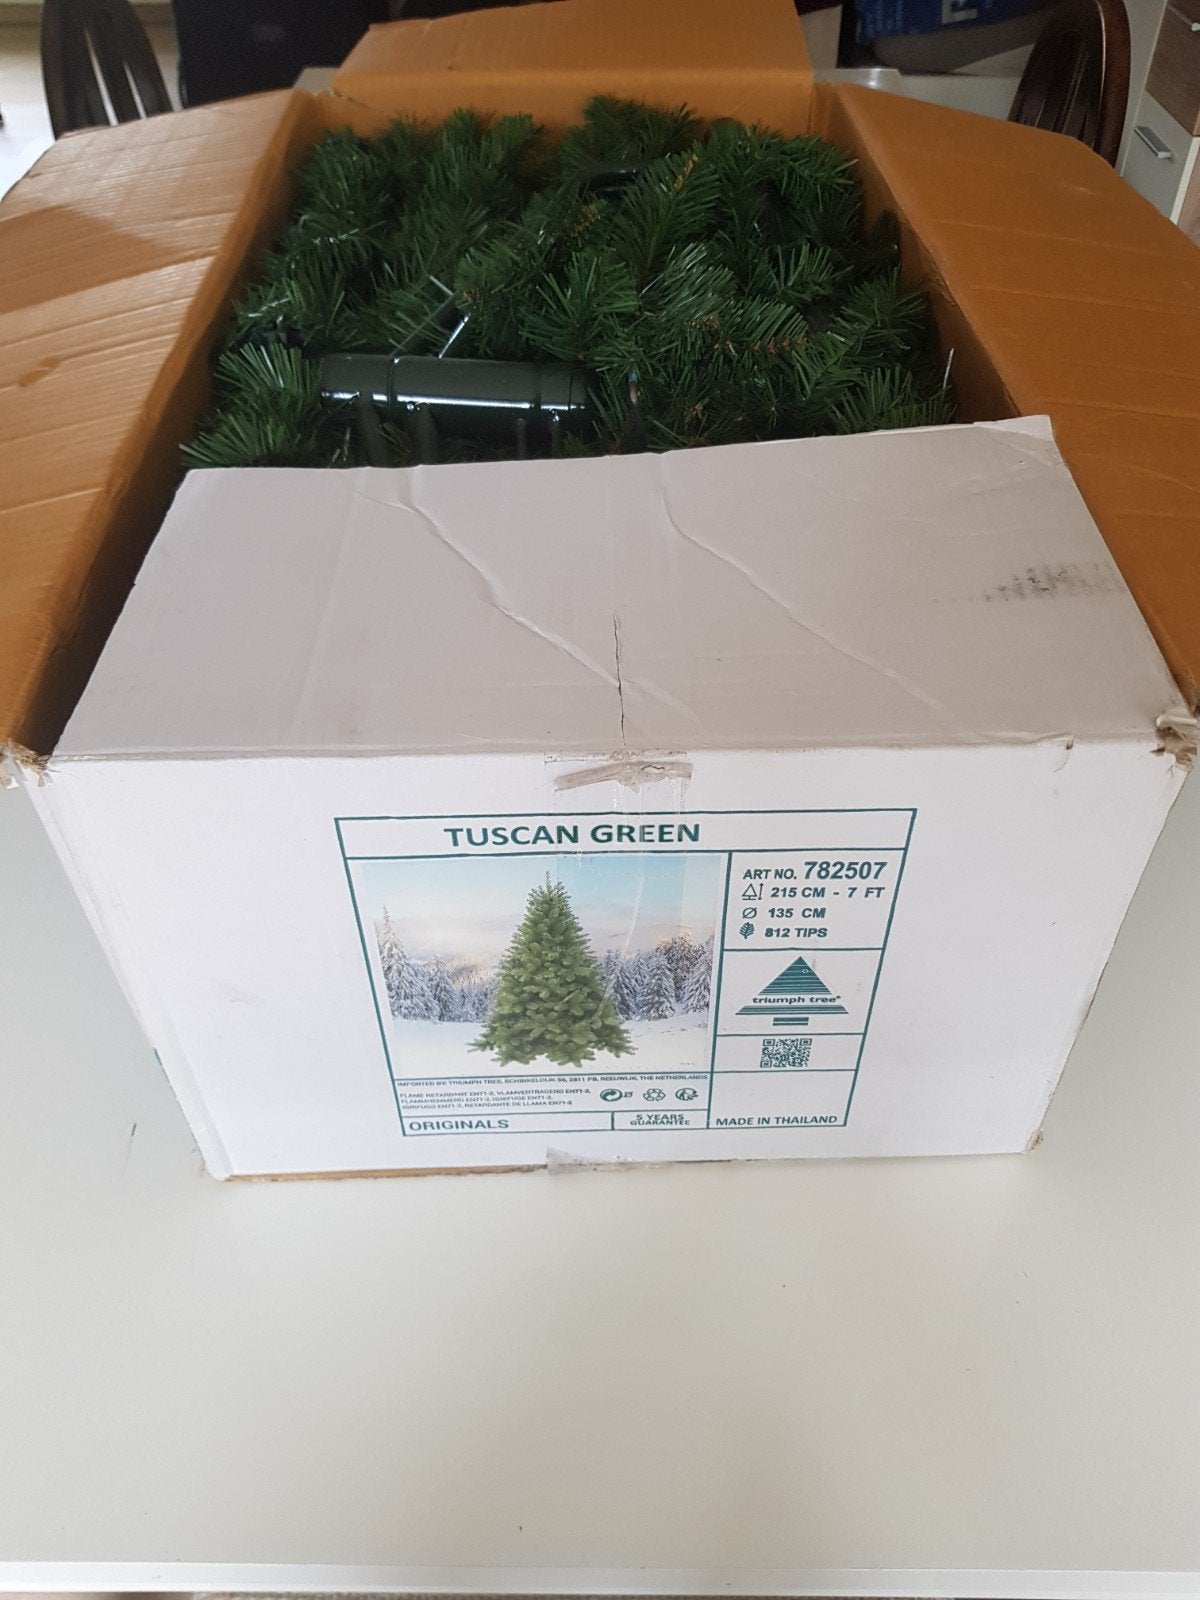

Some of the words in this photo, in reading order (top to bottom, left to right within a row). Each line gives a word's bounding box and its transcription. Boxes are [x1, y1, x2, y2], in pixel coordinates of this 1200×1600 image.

[443, 825, 579, 847] TUSCAN
[590, 823, 700, 843] GREEN
[742, 868, 771, 880] ART
[773, 868, 797, 880] NO.
[804, 861, 888, 880] 782507
[770, 887, 797, 899] 215
[801, 887, 826, 898] CM
[848, 887, 857, 898] 7
[864, 886, 886, 898] FT
[768, 908, 794, 919] 135
[801, 908, 827, 918] CM
[764, 928, 790, 938] 812
[794, 927, 828, 938] TIPS
[752, 996, 805, 1004] triumph
[645, 1113, 685, 1121] YEARS
[715, 1117, 754, 1126] MADE
[757, 1116, 770, 1125] IN
[774, 1115, 838, 1124] THAILAND
[409, 1119, 509, 1131] ORIGINALS
